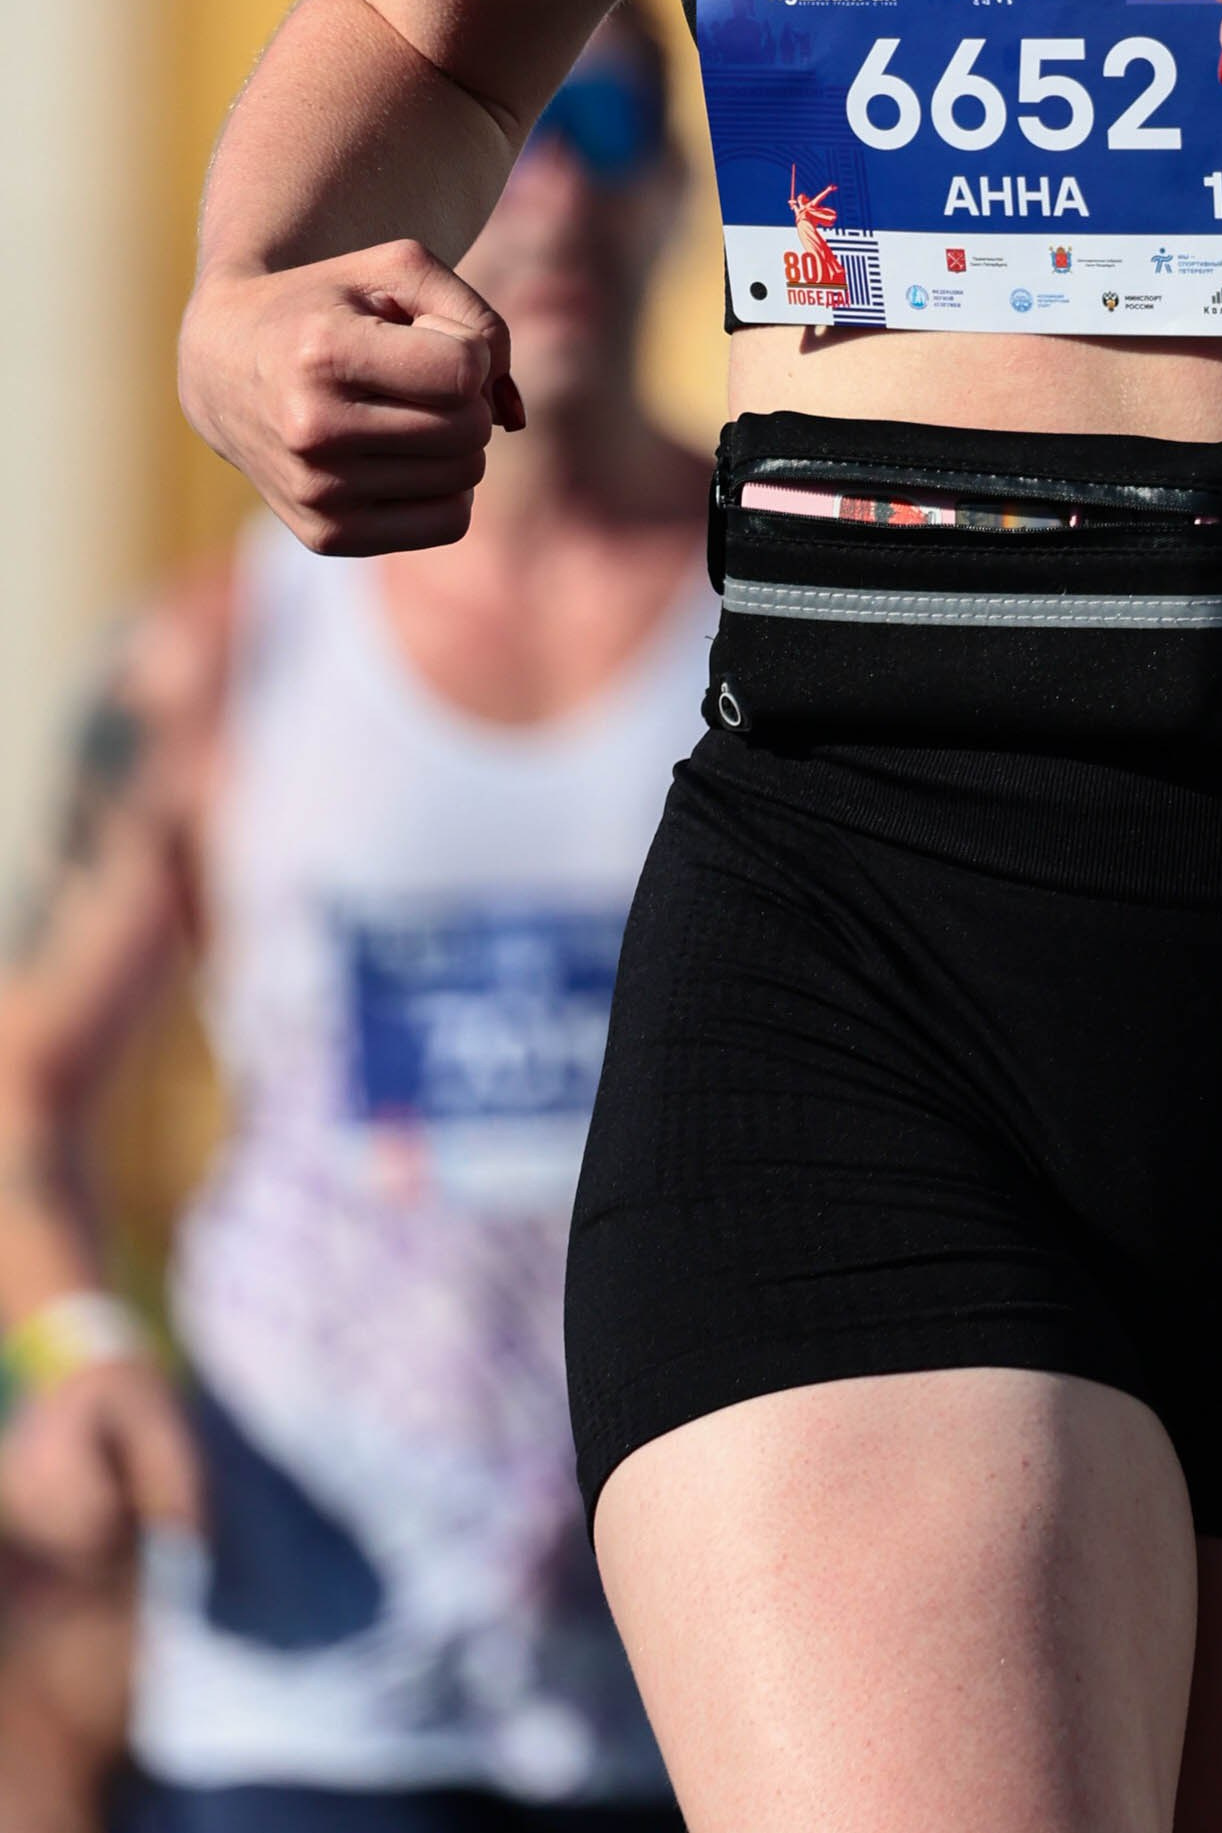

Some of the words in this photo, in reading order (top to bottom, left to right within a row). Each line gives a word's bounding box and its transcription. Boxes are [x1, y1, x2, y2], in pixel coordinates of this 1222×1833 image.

[846, 36, 1182, 151] 6652
[944, 176, 1089, 217] АННА
[784, 252, 818, 283] 80
